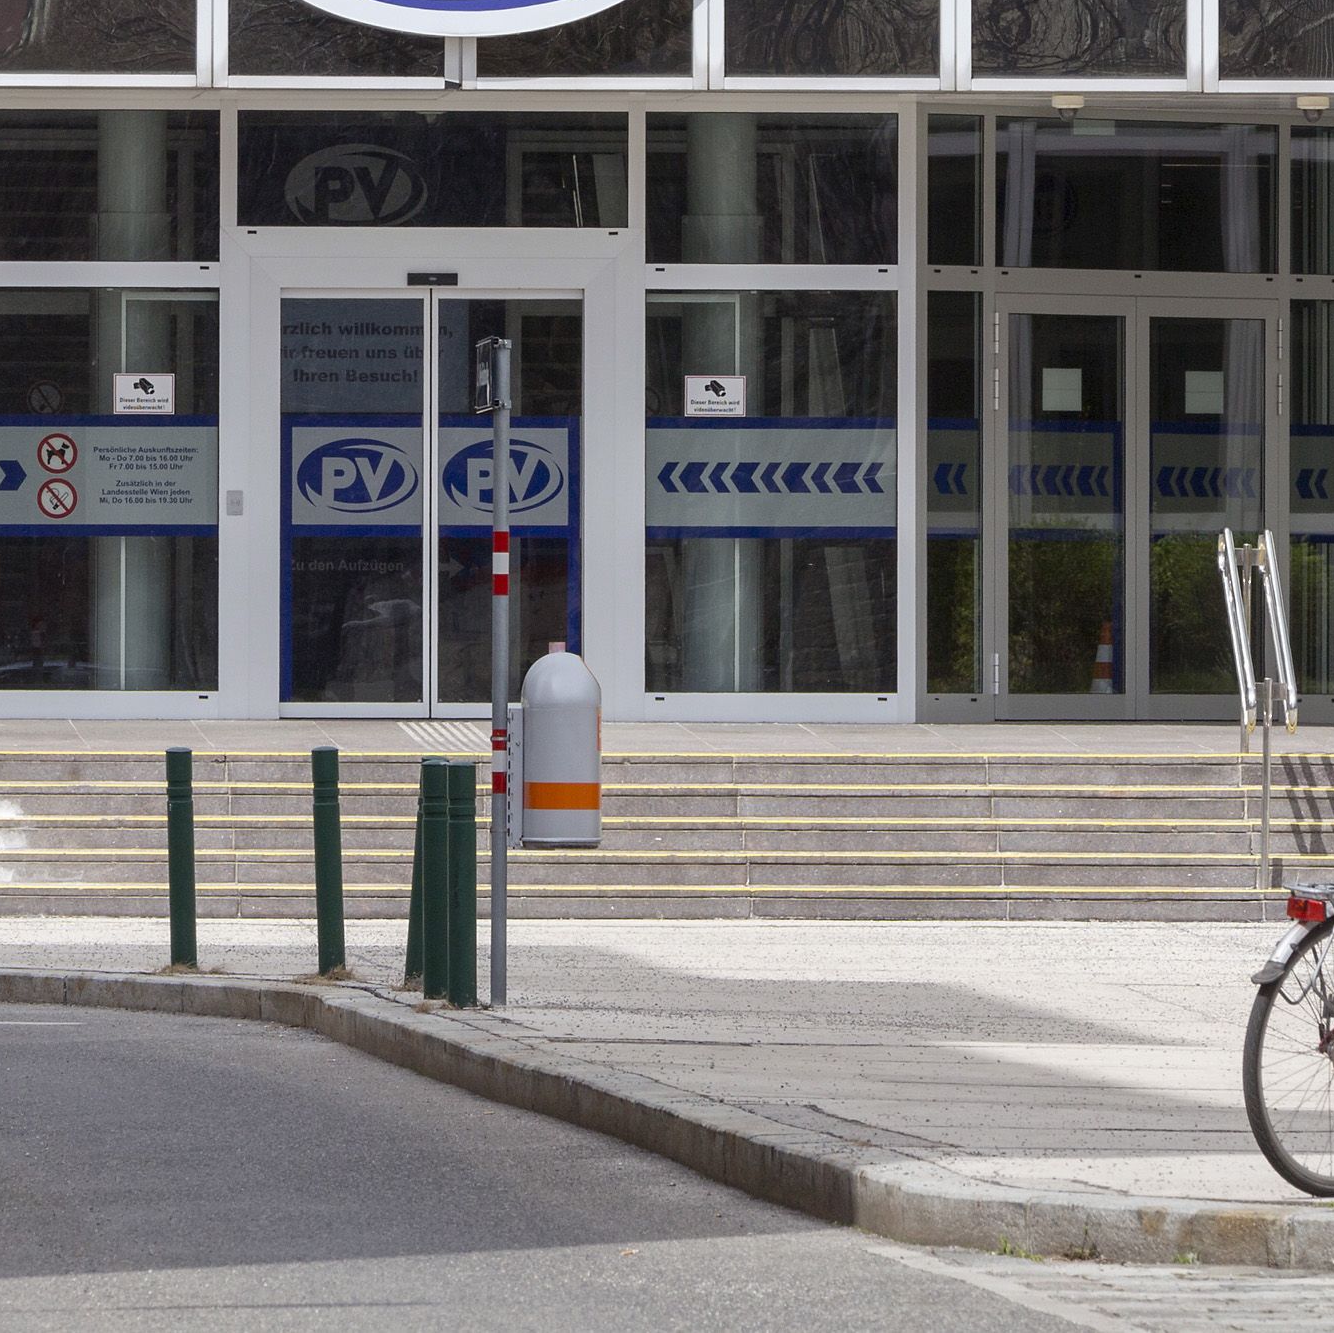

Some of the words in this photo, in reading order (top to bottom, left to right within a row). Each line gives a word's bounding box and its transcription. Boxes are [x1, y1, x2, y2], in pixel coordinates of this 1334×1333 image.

[282, 321, 332, 335] rzlich
[337, 321, 453, 338] willkommn,
[365, 348, 398, 360] uns
[403, 345, 444, 359] übr
[292, 368, 340, 383] Ihren
[345, 368, 418, 383] Besuch!
[93, 446, 137, 454] Persönliche
[101, 488, 148, 496] Landesstelle
[149, 488, 168, 496] Wien
[169, 488, 191, 497] jeden
[308, 559, 335, 571] den
